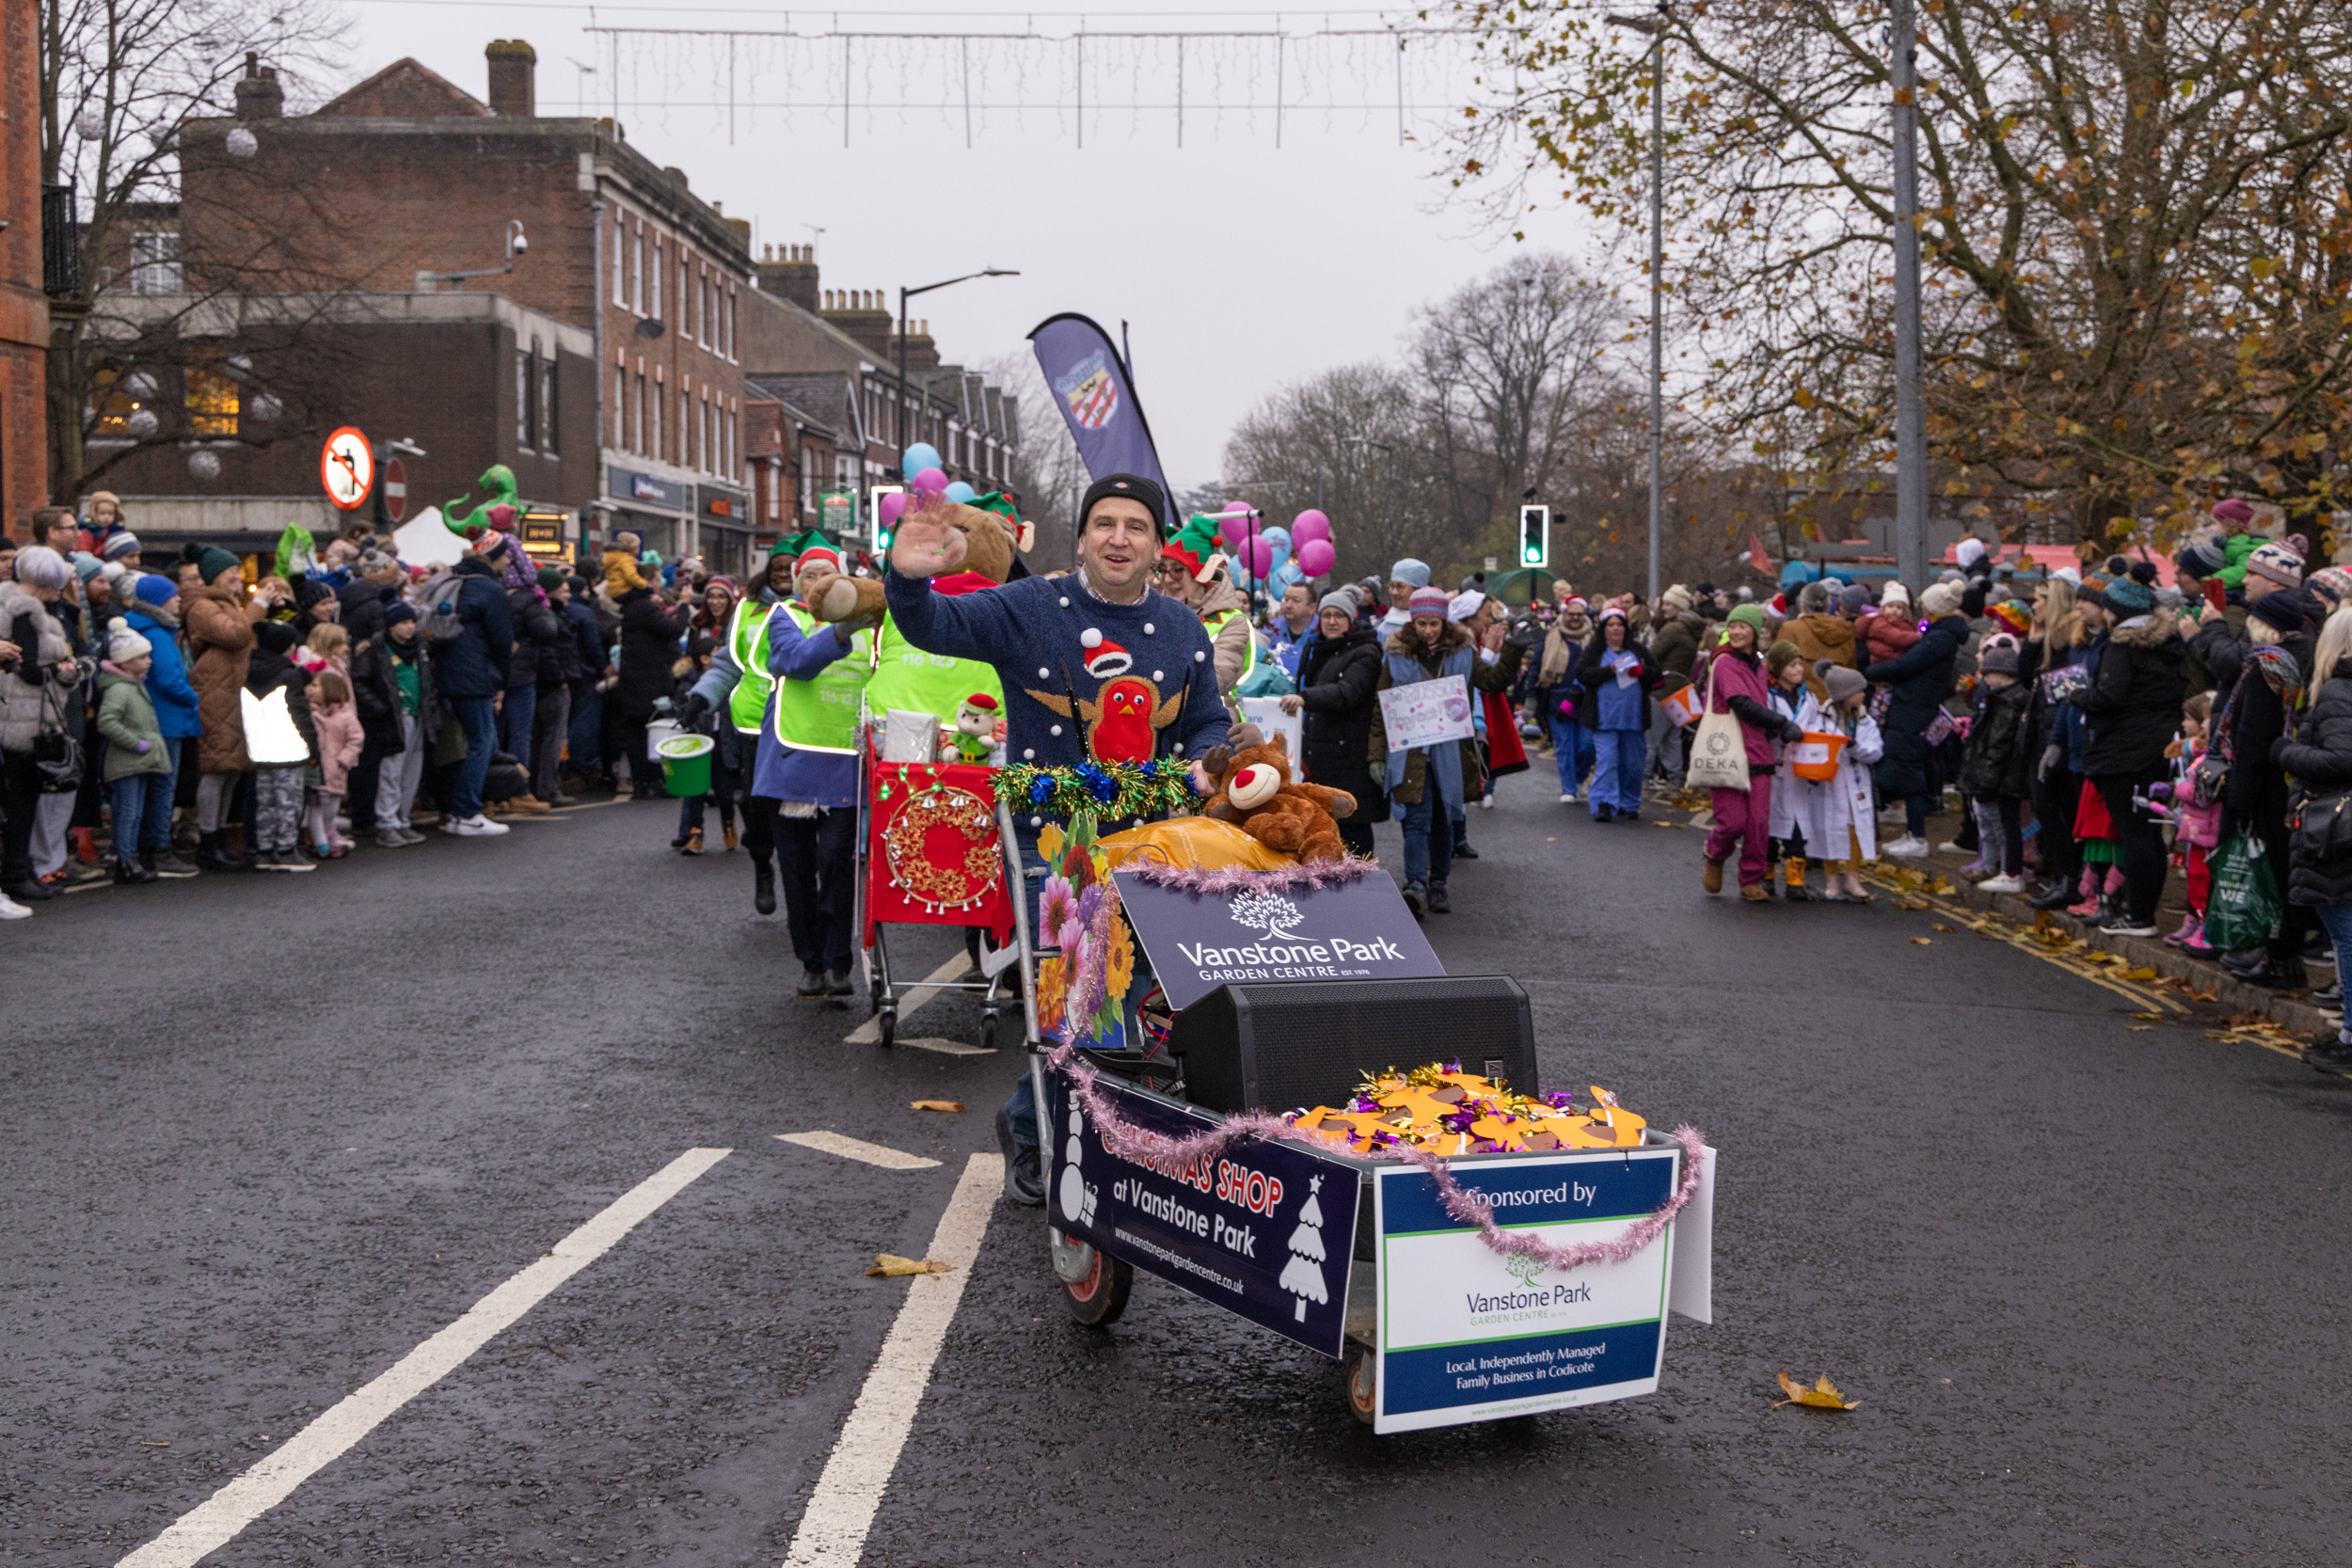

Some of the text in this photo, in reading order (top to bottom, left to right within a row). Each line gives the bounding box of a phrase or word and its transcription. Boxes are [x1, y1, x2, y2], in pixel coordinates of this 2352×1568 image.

[902, 653, 956, 668] 116 123
[820, 690, 860, 706] 116 123
[1694, 757, 1739, 770] DEKA
[1176, 936, 1406, 966] Vanstone Park
[1199, 968, 1270, 981] GARDEN
[1273, 965, 1339, 978] CENTRE
[1216, 1158, 1283, 1218] SHOP
[1573, 1180, 1597, 1207] by
[1113, 1178, 1257, 1259] at Vanstone Park
[1114, 1227, 1245, 1295] www.vanstoneparkgardencentre.co.uk
[1466, 1281, 1592, 1314] Vanstone Park
[1470, 1313, 1514, 1326] GARDEN
[1513, 1309, 1549, 1322] CENTRE
[1446, 1341, 1607, 1374] Local, Independently Managed
[1456, 1361, 1596, 1390] Family Business in Codicote
